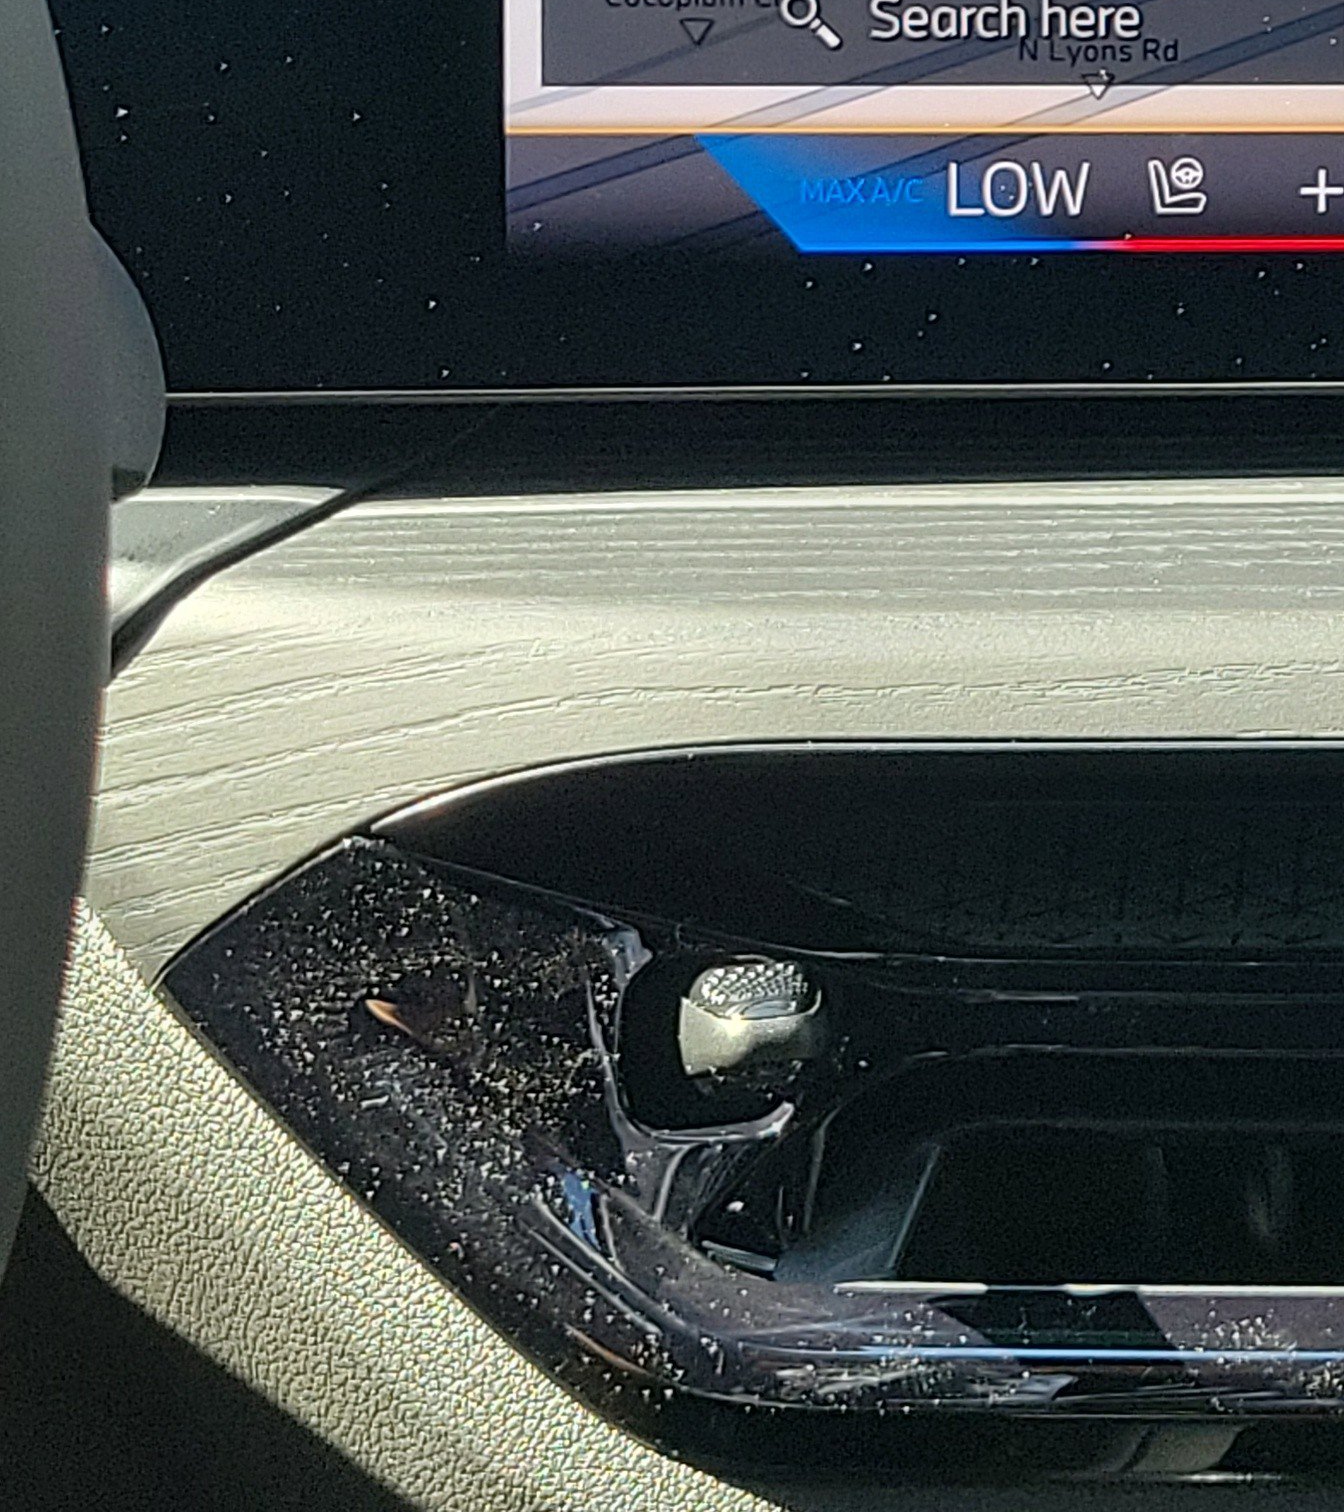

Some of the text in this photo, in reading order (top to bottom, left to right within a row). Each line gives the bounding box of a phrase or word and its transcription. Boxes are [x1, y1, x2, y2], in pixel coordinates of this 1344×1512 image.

[1019, 39, 1178, 68] N Lyons Rd
[801, 177, 924, 204] MAX A/C
[948, 160, 1091, 217] LOW
